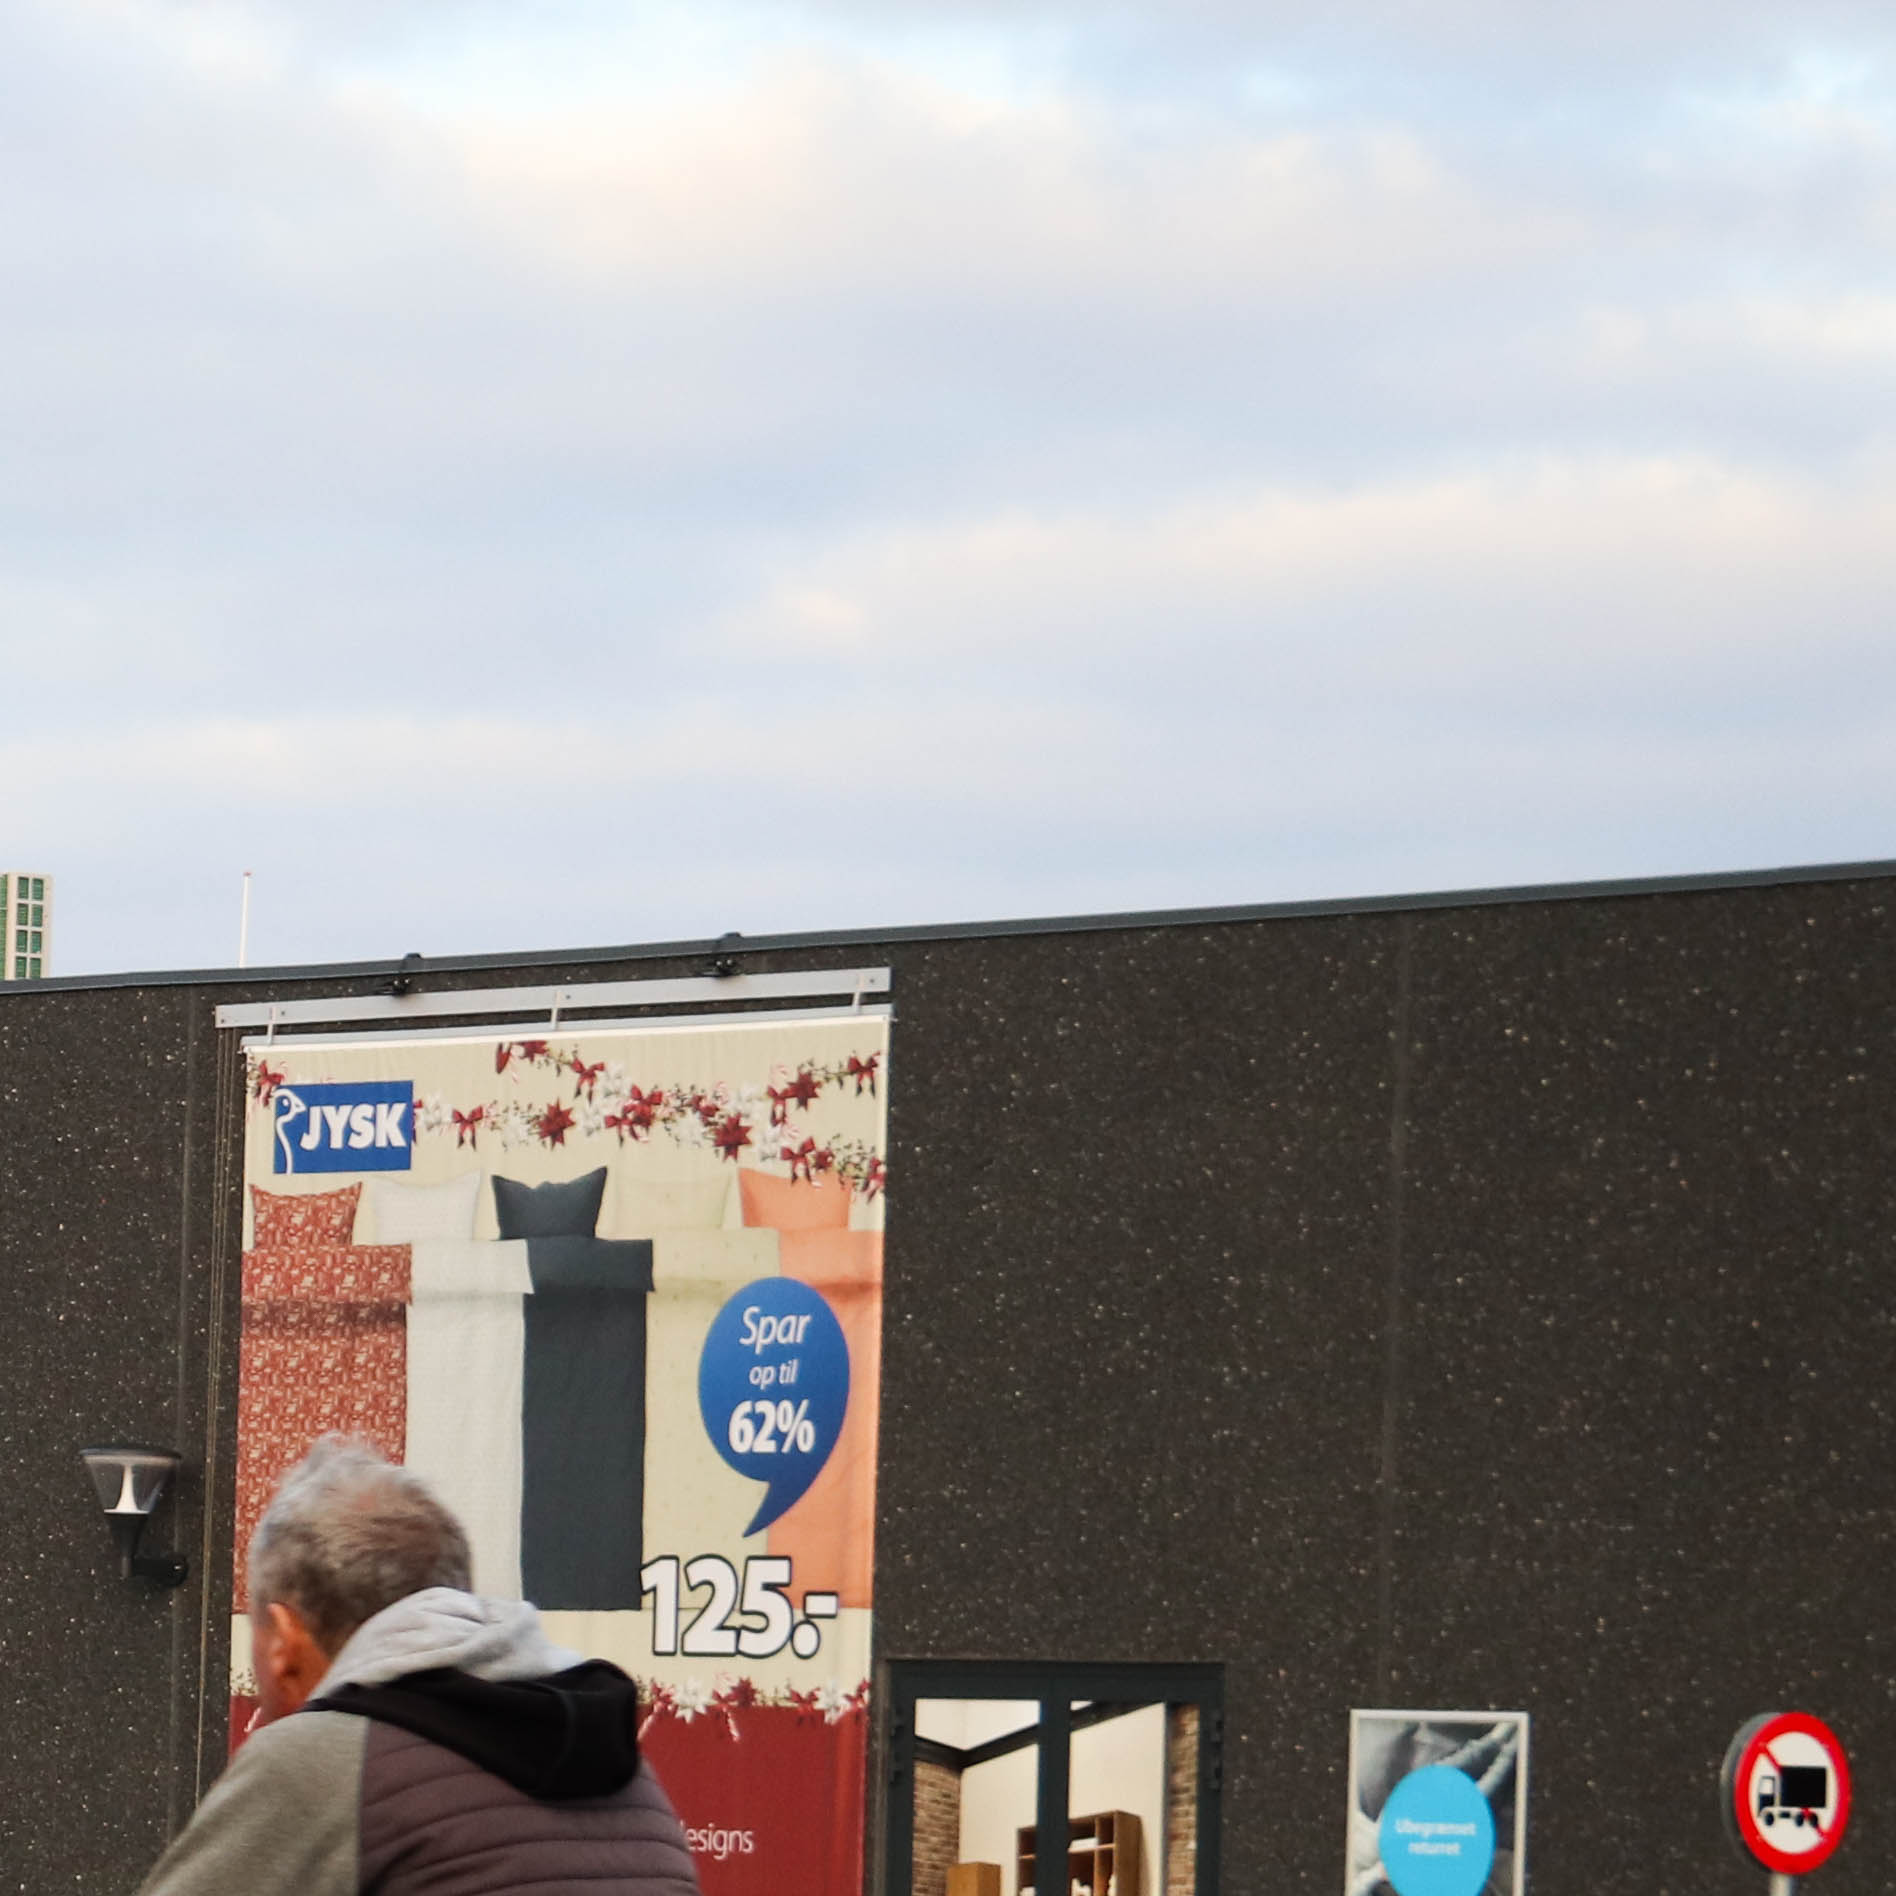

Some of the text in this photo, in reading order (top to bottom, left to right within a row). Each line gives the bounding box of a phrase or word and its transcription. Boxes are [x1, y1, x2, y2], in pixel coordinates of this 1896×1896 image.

[299, 1102, 408, 1152] JYSK
[739, 1305, 811, 1355] Spar
[749, 1360, 799, 1390] op til
[728, 1399, 816, 1455] 62%
[679, 1819, 754, 1861] esigns
